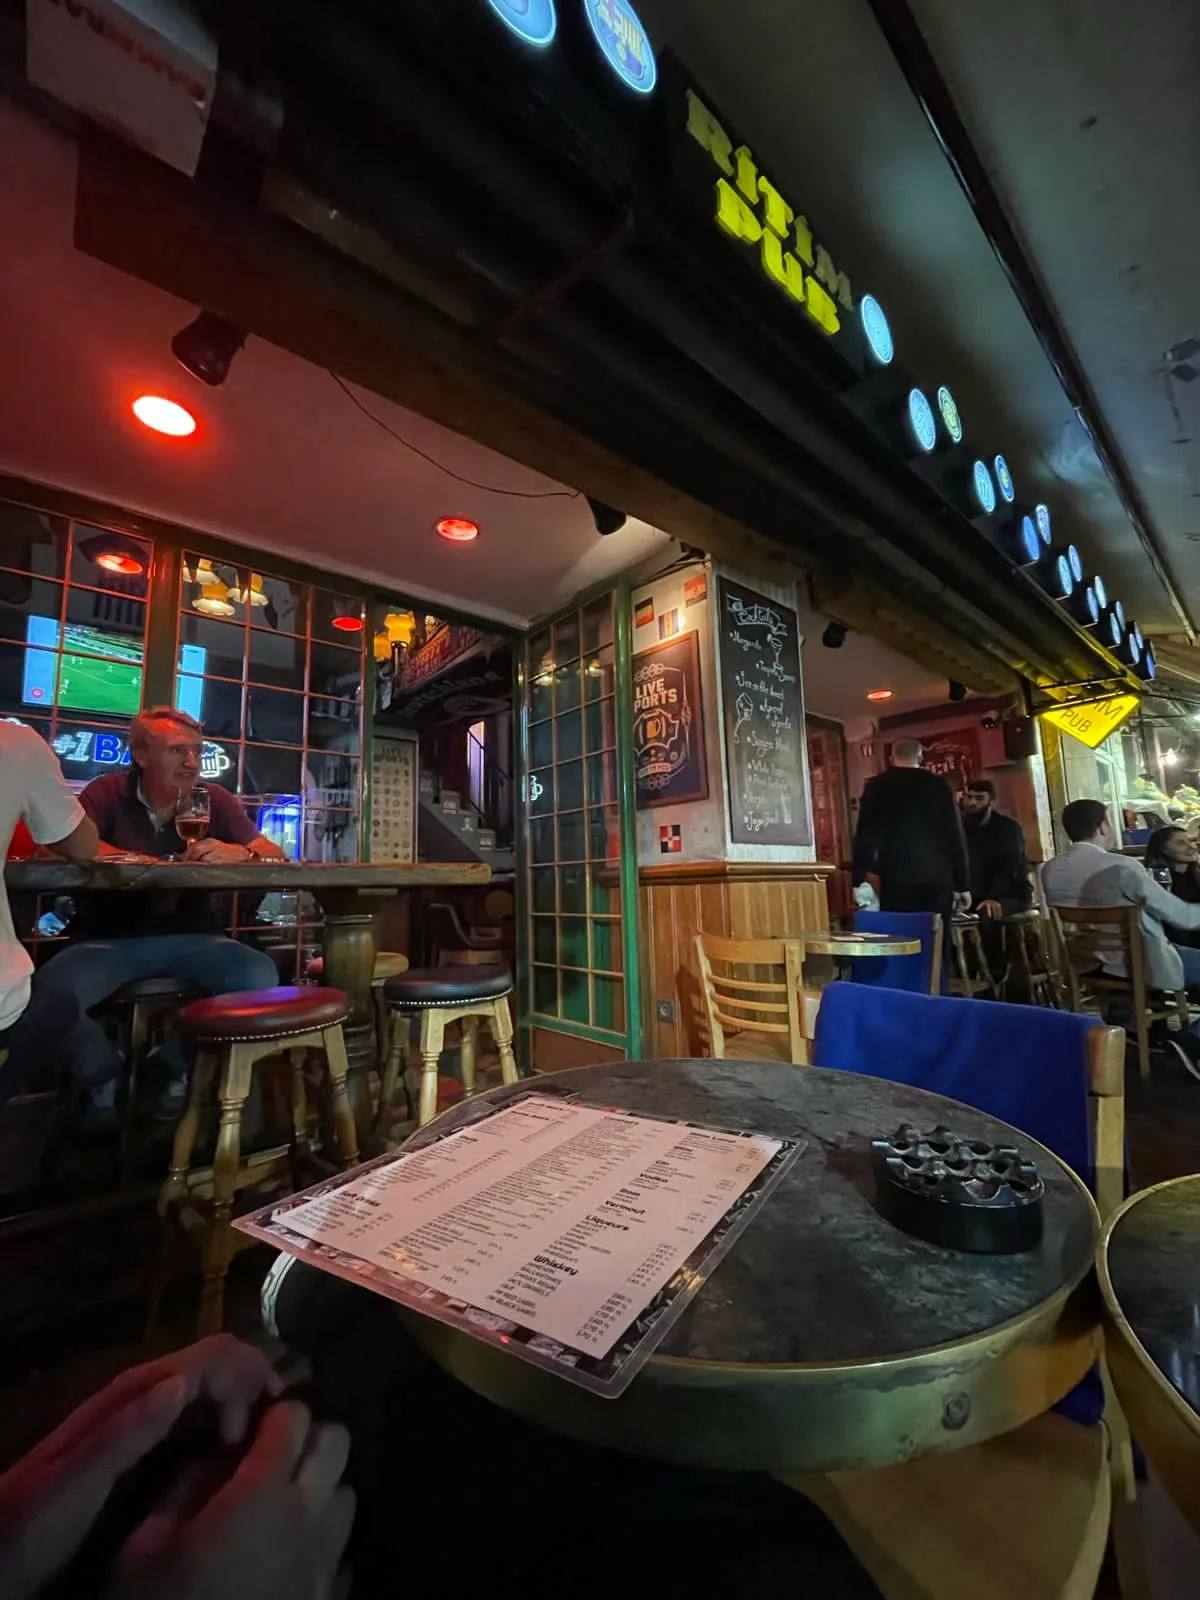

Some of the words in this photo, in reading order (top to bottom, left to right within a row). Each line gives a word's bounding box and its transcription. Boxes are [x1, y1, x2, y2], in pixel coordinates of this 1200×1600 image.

[715, 177, 841, 336] PUB
[636, 678, 665, 700] LIVE
[634, 688, 678, 713] PORTS
[1060, 708, 1093, 733] PUB
[605, 1200, 646, 1215] Vermout
[586, 1215, 629, 1231] Liqueurs
[533, 1254, 578, 1276] Whiskey
